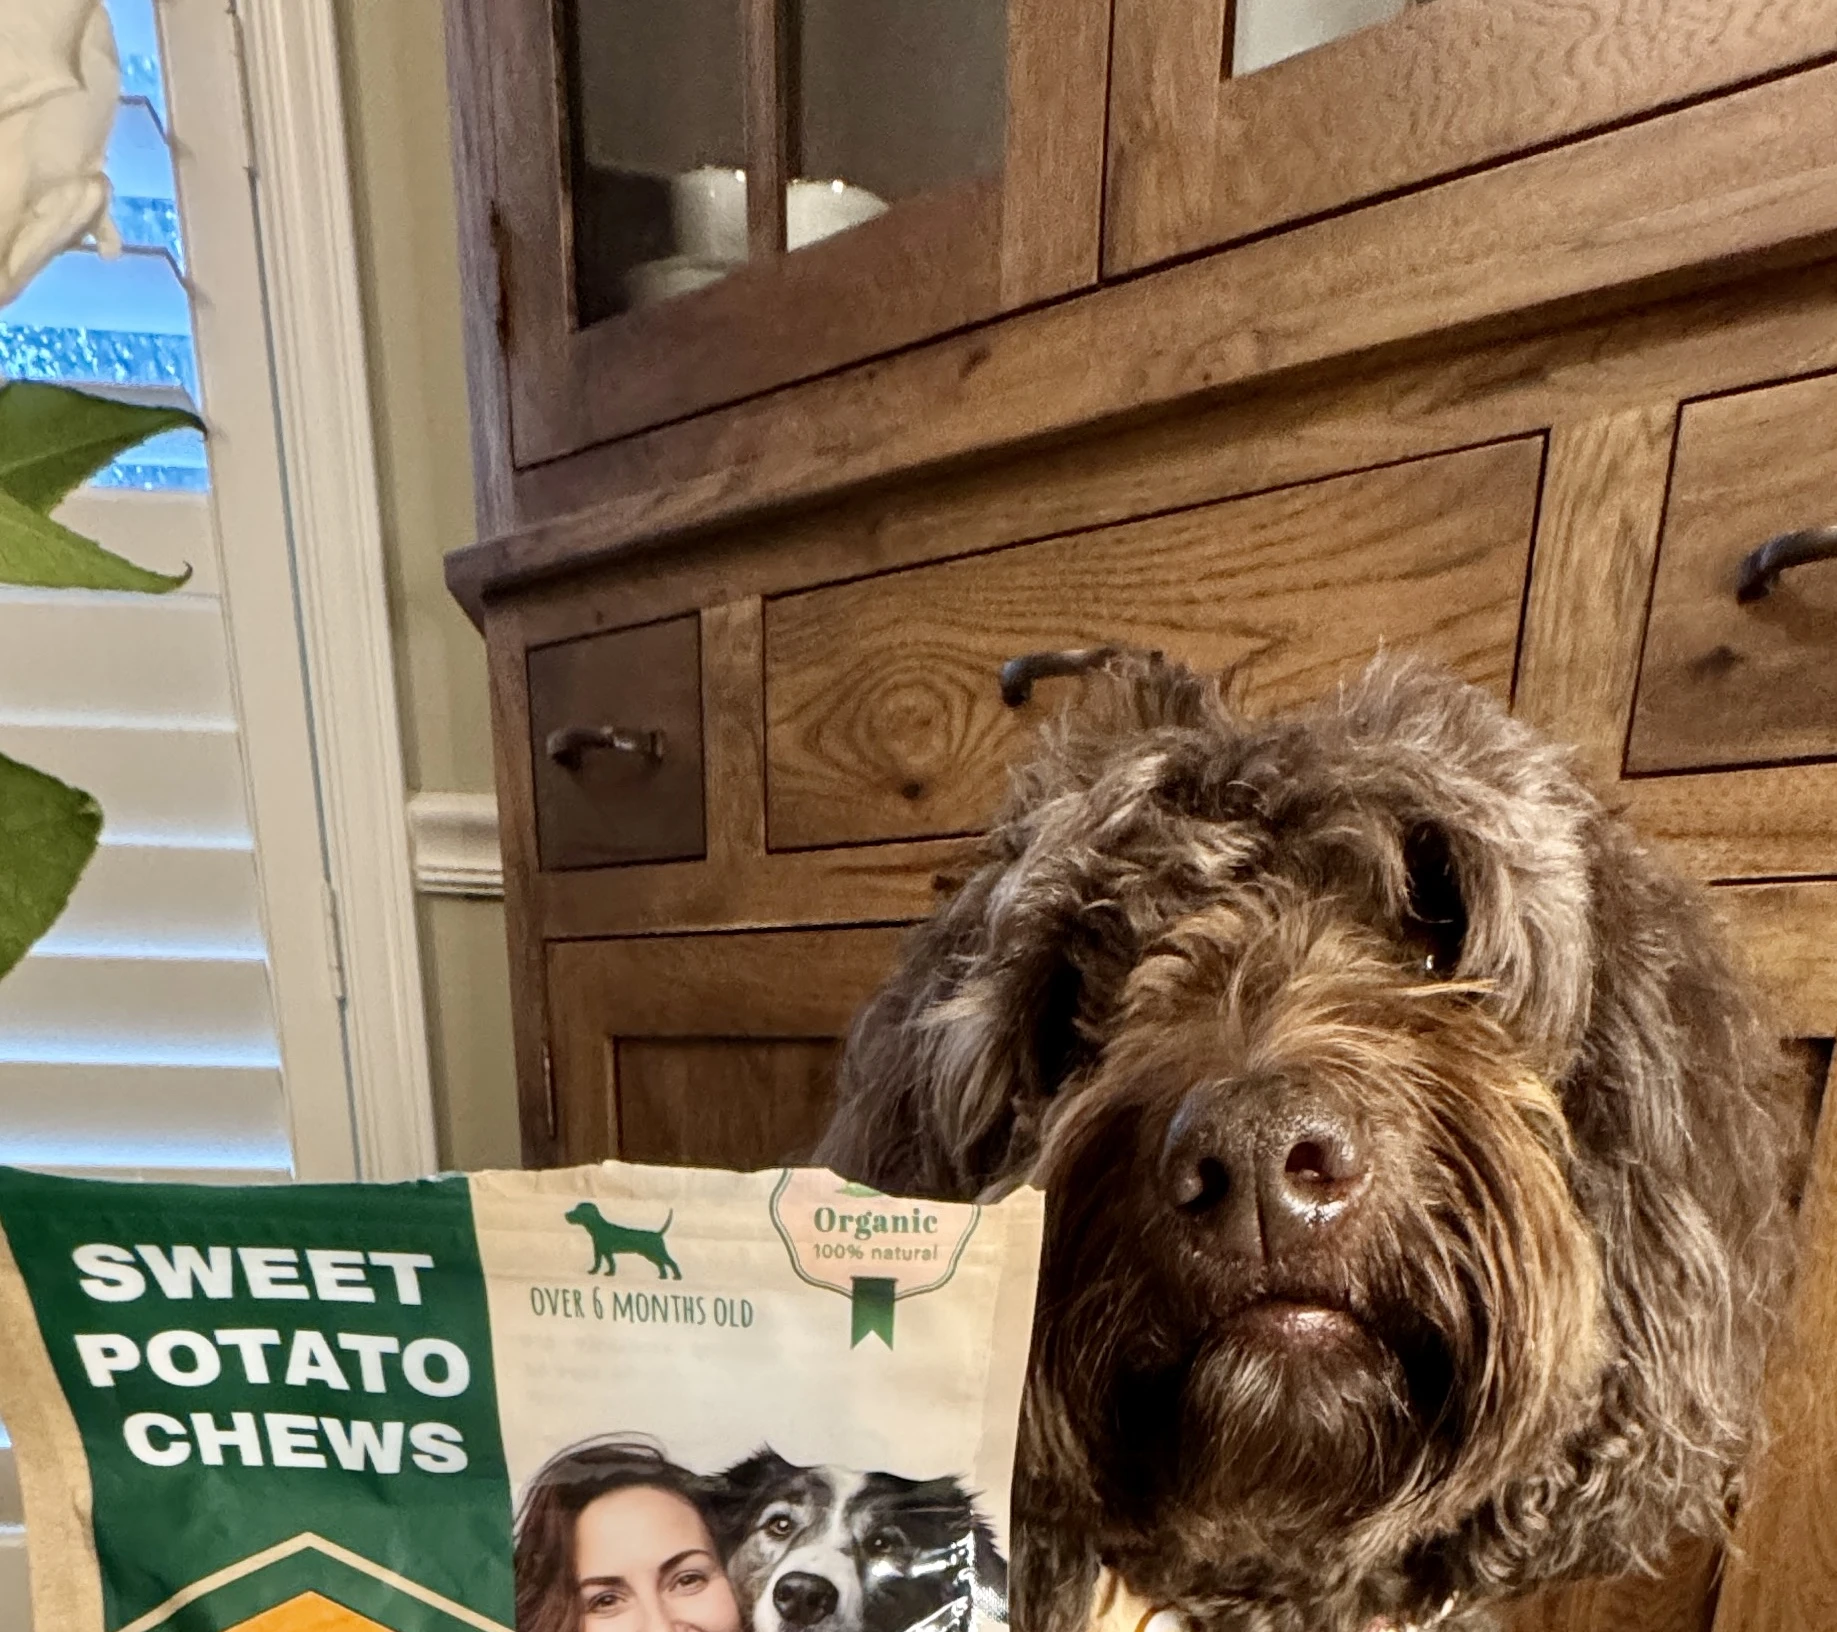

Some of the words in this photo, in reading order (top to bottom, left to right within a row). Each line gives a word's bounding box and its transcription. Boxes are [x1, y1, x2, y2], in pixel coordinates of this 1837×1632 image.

[813, 1206, 938, 1241] Organic
[72, 1243, 434, 1306] SWEET
[813, 1243, 865, 1260] 100%
[871, 1243, 938, 1262] natural
[529, 1286, 585, 1319] OVER
[592, 1286, 604, 1321] 6
[612, 1291, 706, 1326] MONTHS
[713, 1296, 754, 1329] OLD
[74, 1328, 470, 1398] POTATO
[123, 1411, 468, 1474] CHEWS
